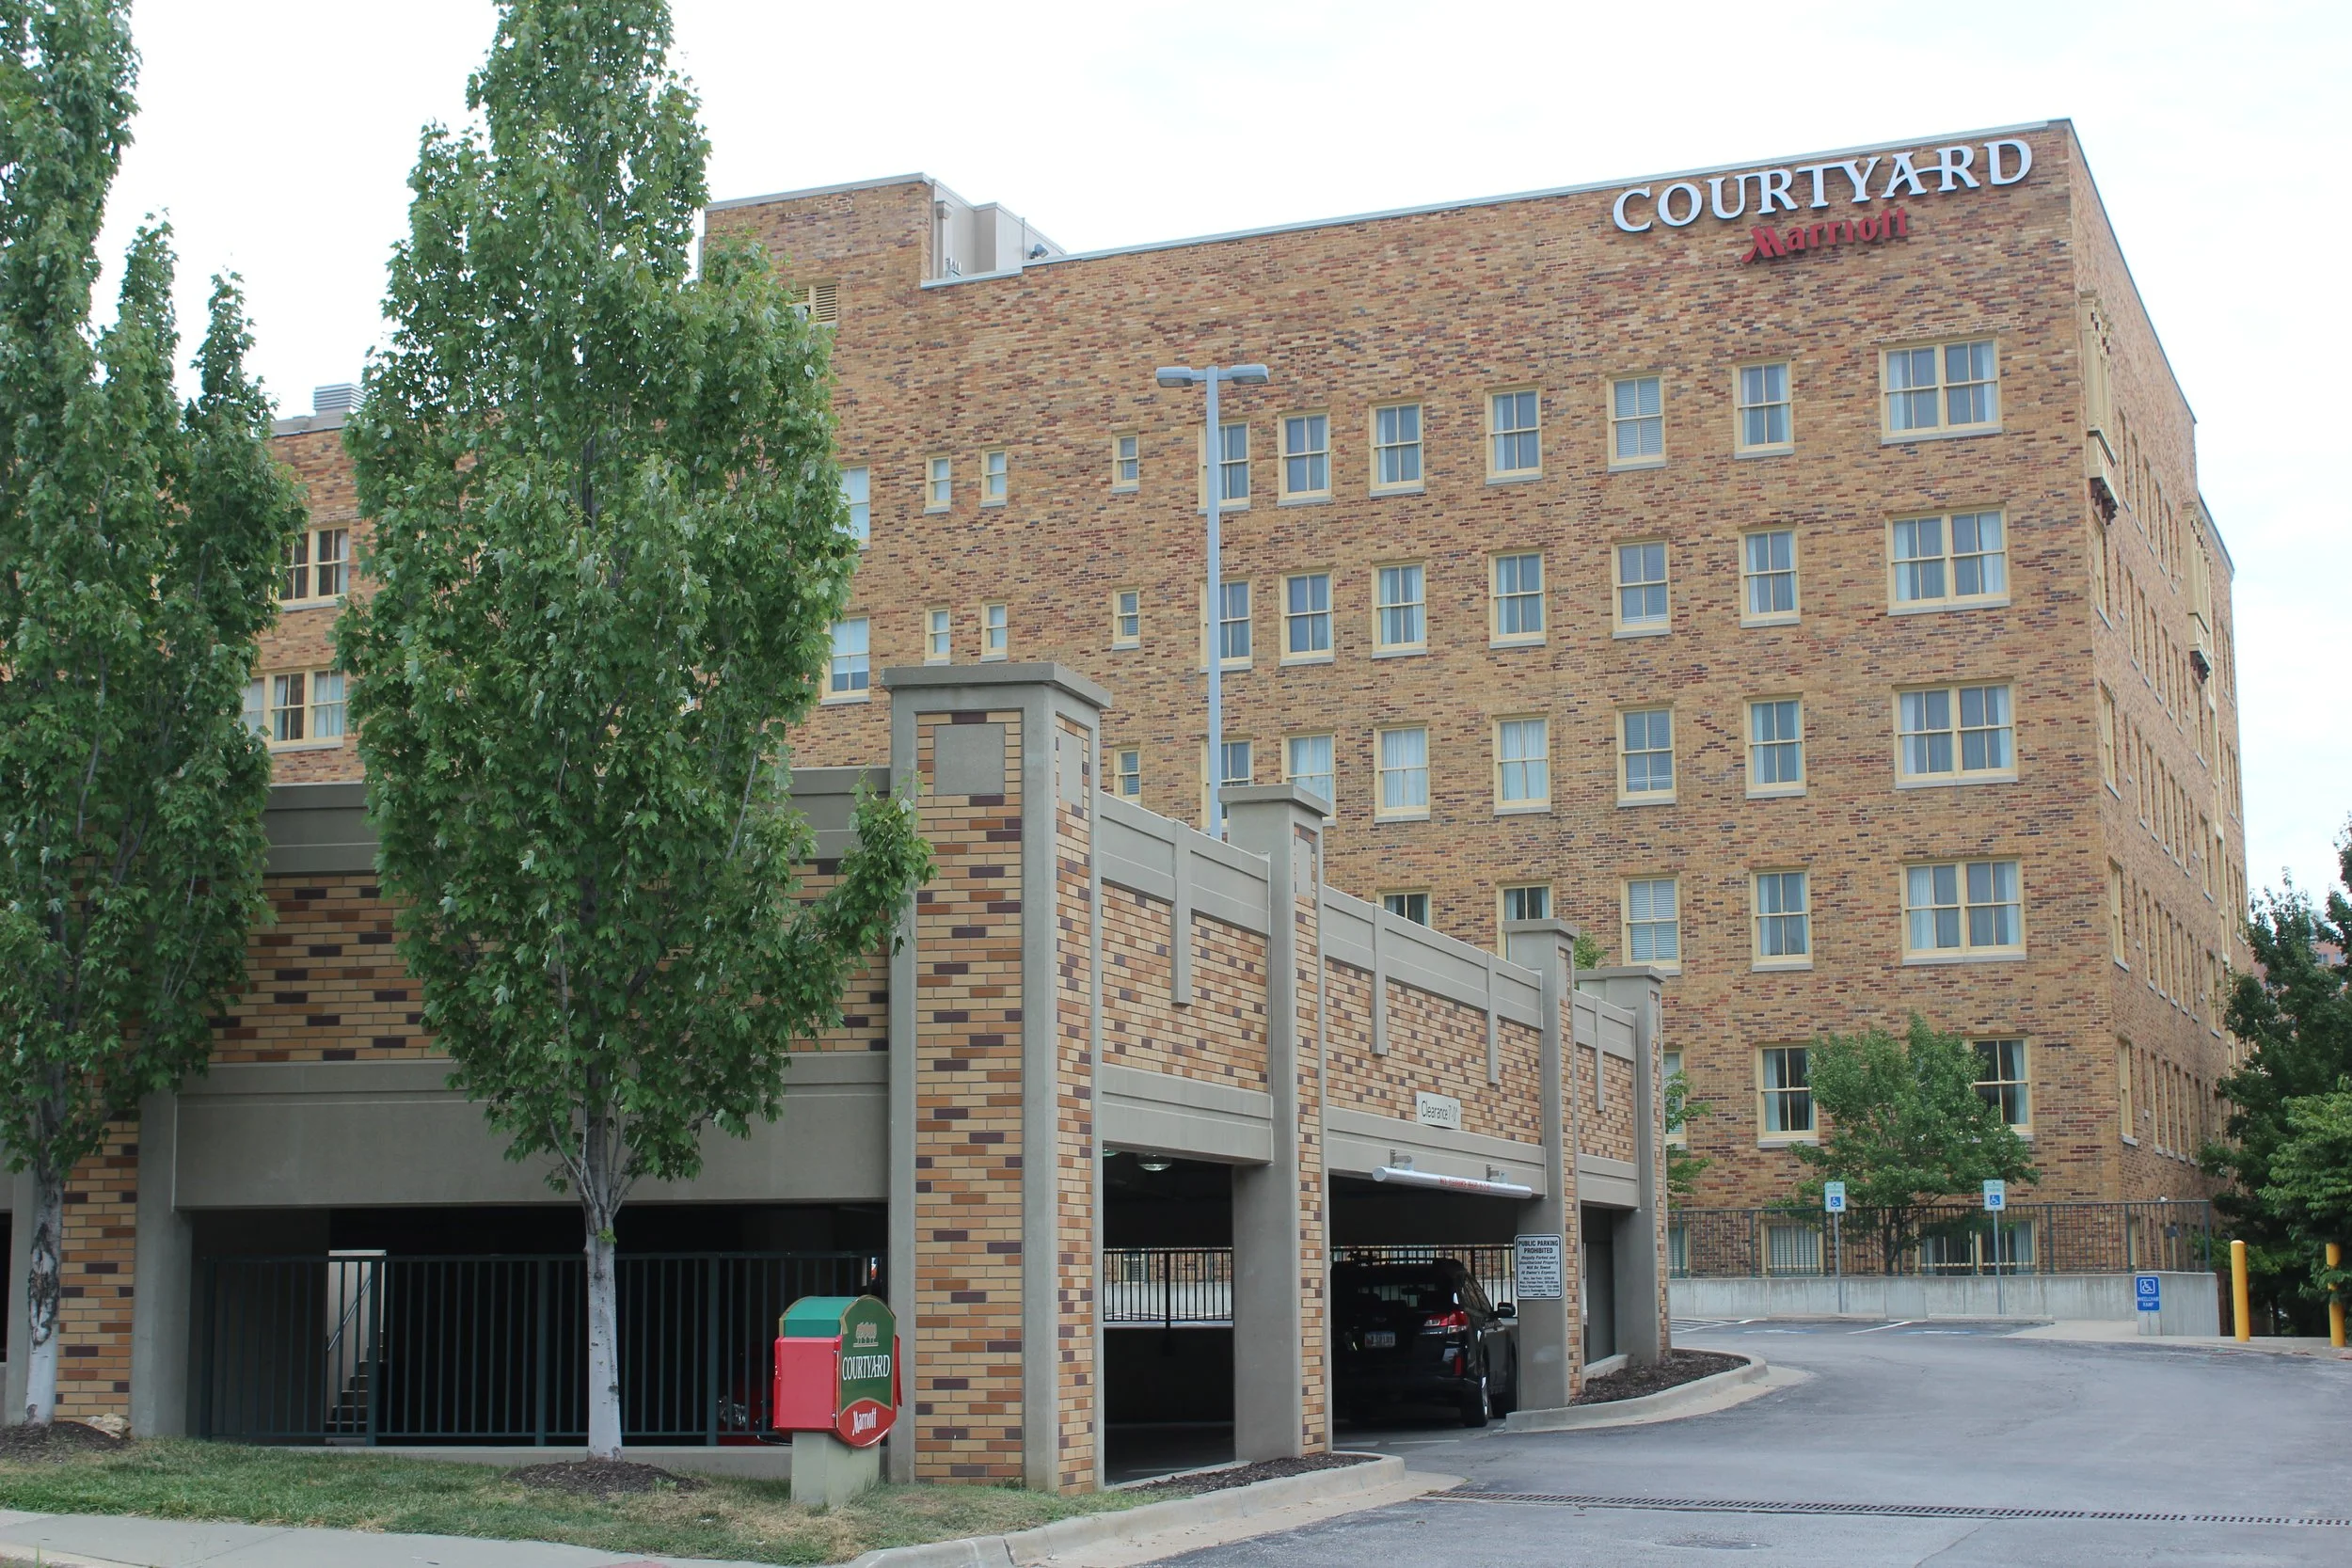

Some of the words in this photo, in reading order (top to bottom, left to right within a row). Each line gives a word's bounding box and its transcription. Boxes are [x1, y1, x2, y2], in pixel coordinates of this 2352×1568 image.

[1613, 138, 2033, 233] COURTYARD
[1740, 206, 1908, 263] Marriott
[1422, 1100, 1448, 1120] Clearance
[842, 1354, 891, 1381] COURTYARD
[851, 1407, 877, 1436] Marriott
